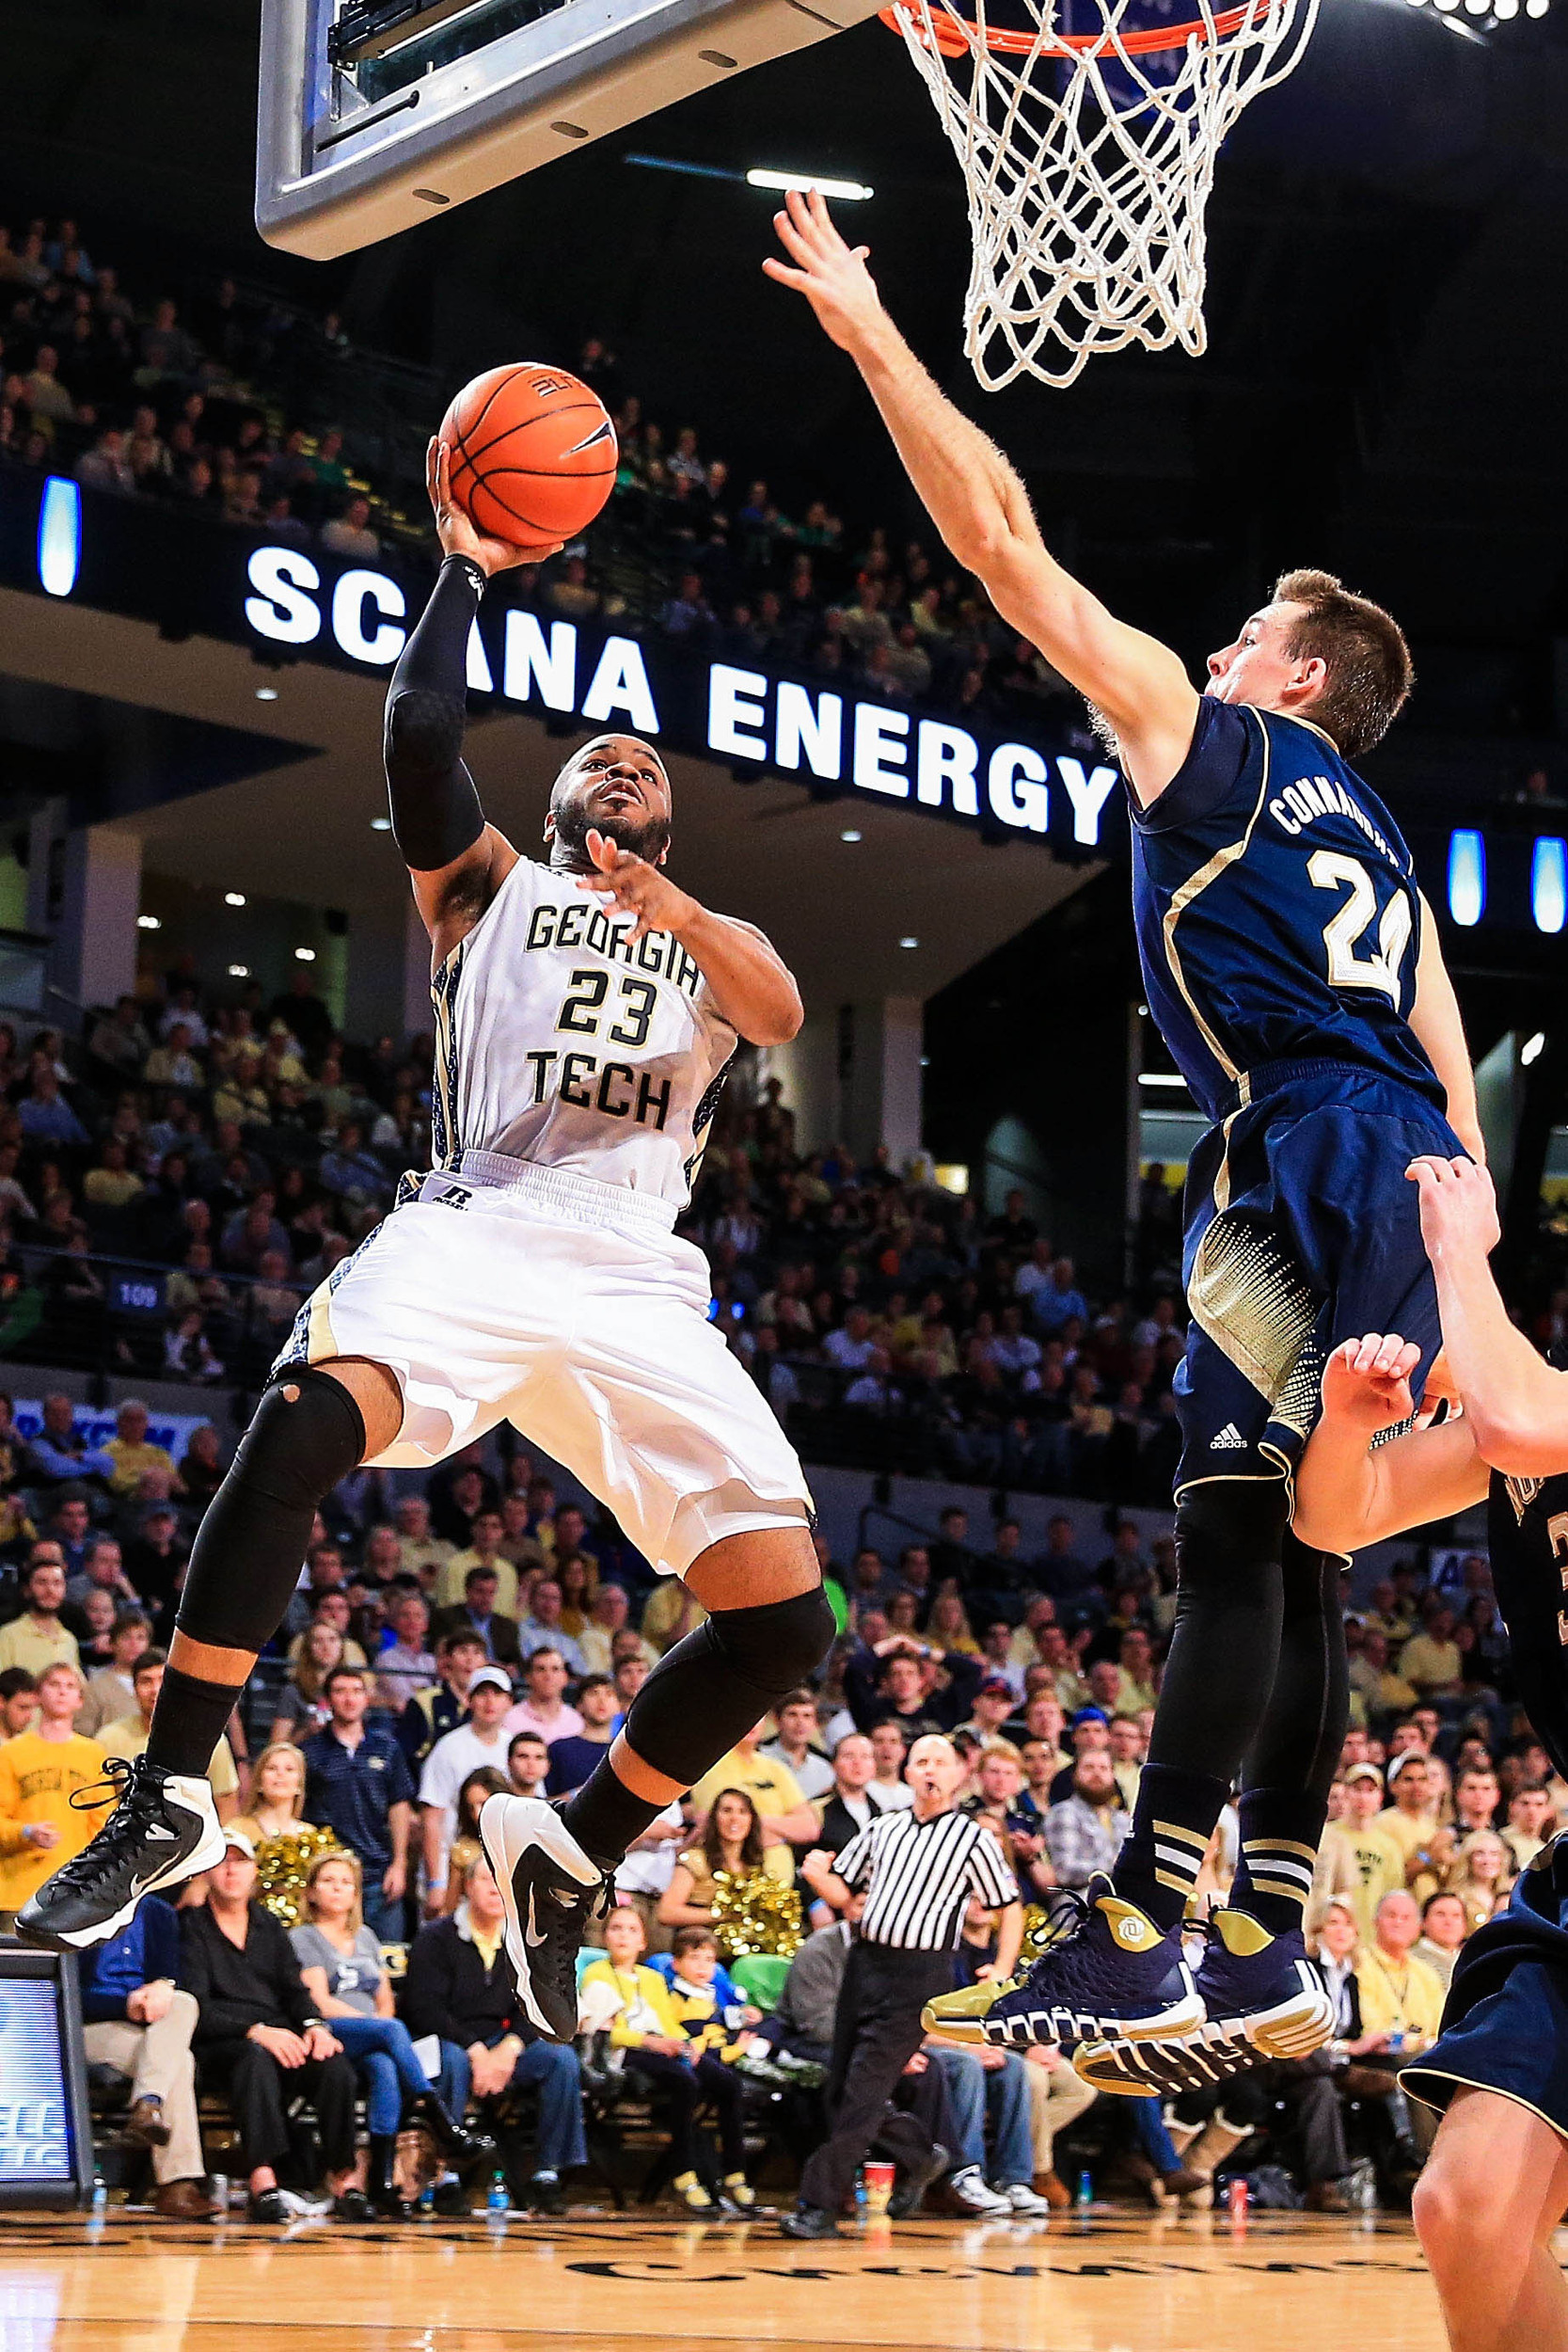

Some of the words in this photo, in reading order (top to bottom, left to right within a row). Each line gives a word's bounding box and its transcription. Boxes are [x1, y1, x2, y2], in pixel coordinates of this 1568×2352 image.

[707, 662, 1117, 845] ENERGY
[525, 903, 703, 998] GEORGIA
[556, 968, 659, 1050] 23
[525, 1049, 672, 1132] TECH
[1210, 1438, 1248, 1450] adidas
